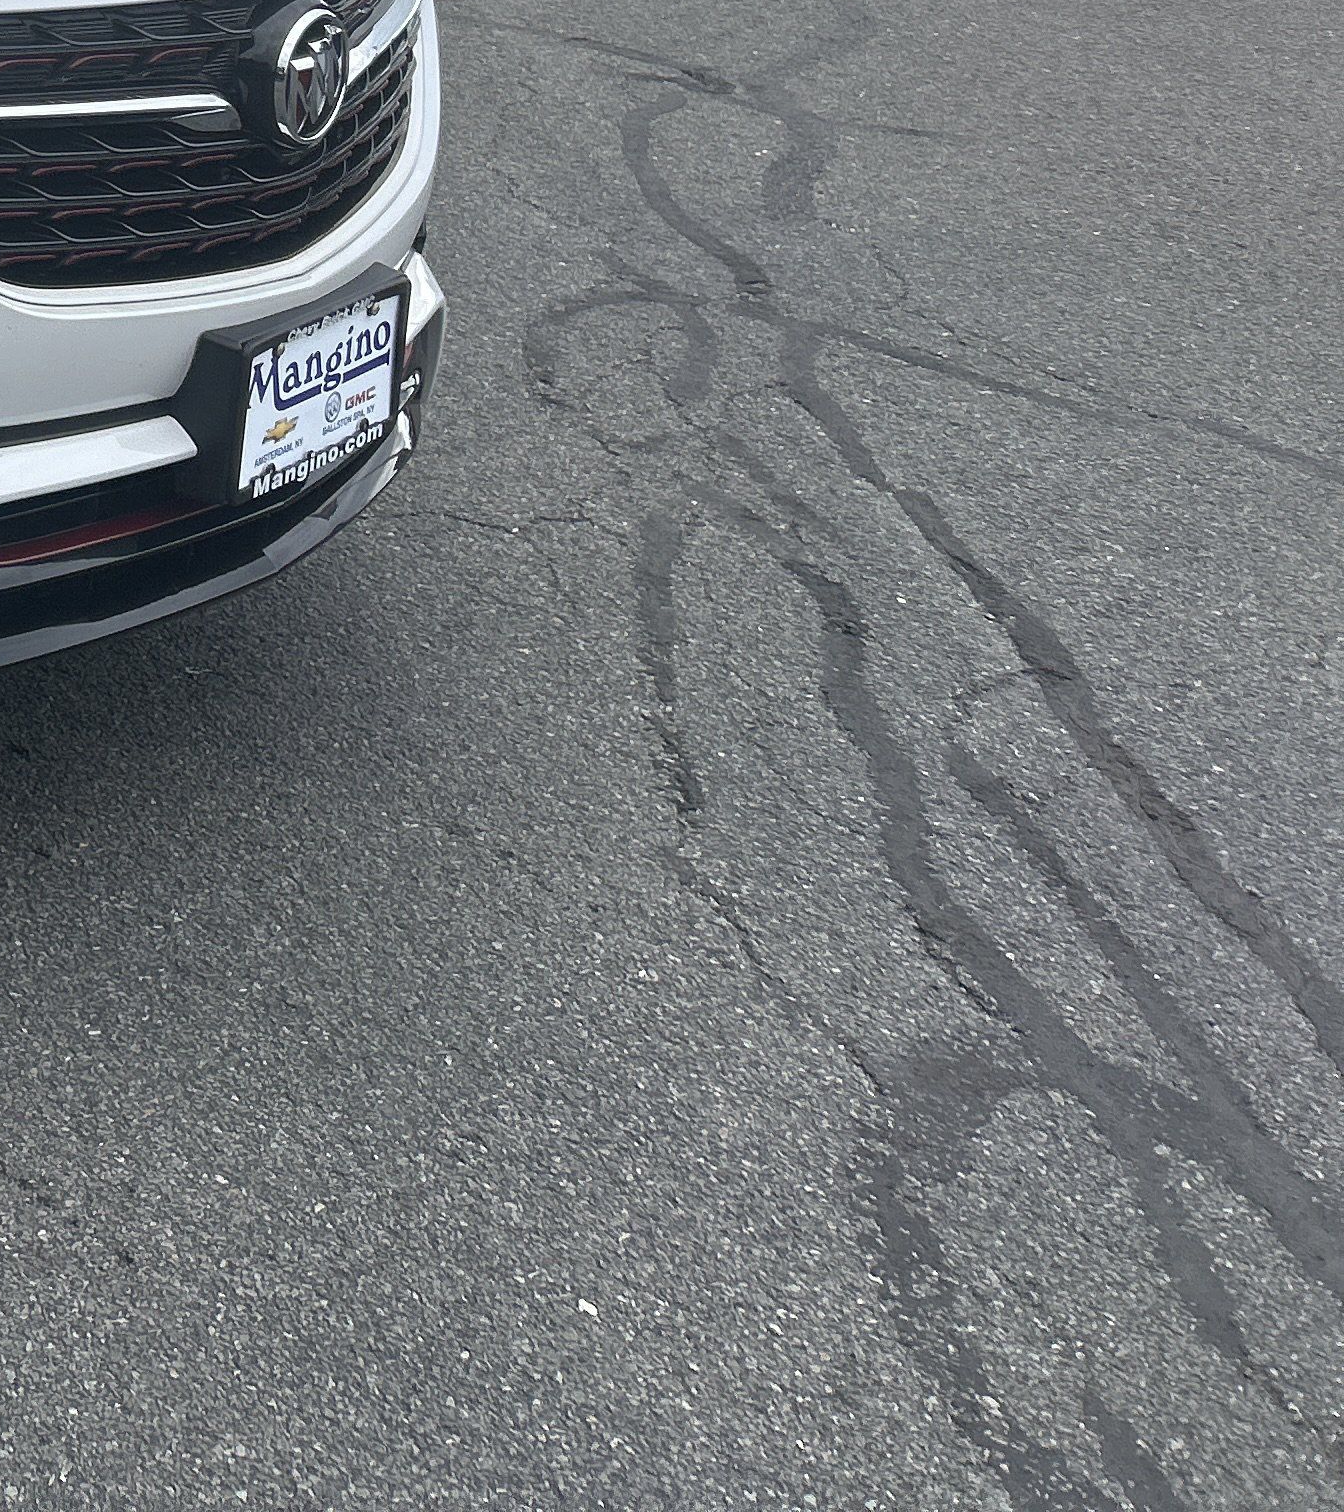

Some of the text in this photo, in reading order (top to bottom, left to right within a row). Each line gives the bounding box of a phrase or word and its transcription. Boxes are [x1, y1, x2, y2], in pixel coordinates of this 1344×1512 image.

[249, 320, 391, 410] Mangino
[345, 385, 377, 410] GMC
[252, 423, 384, 499] Mangino.com
